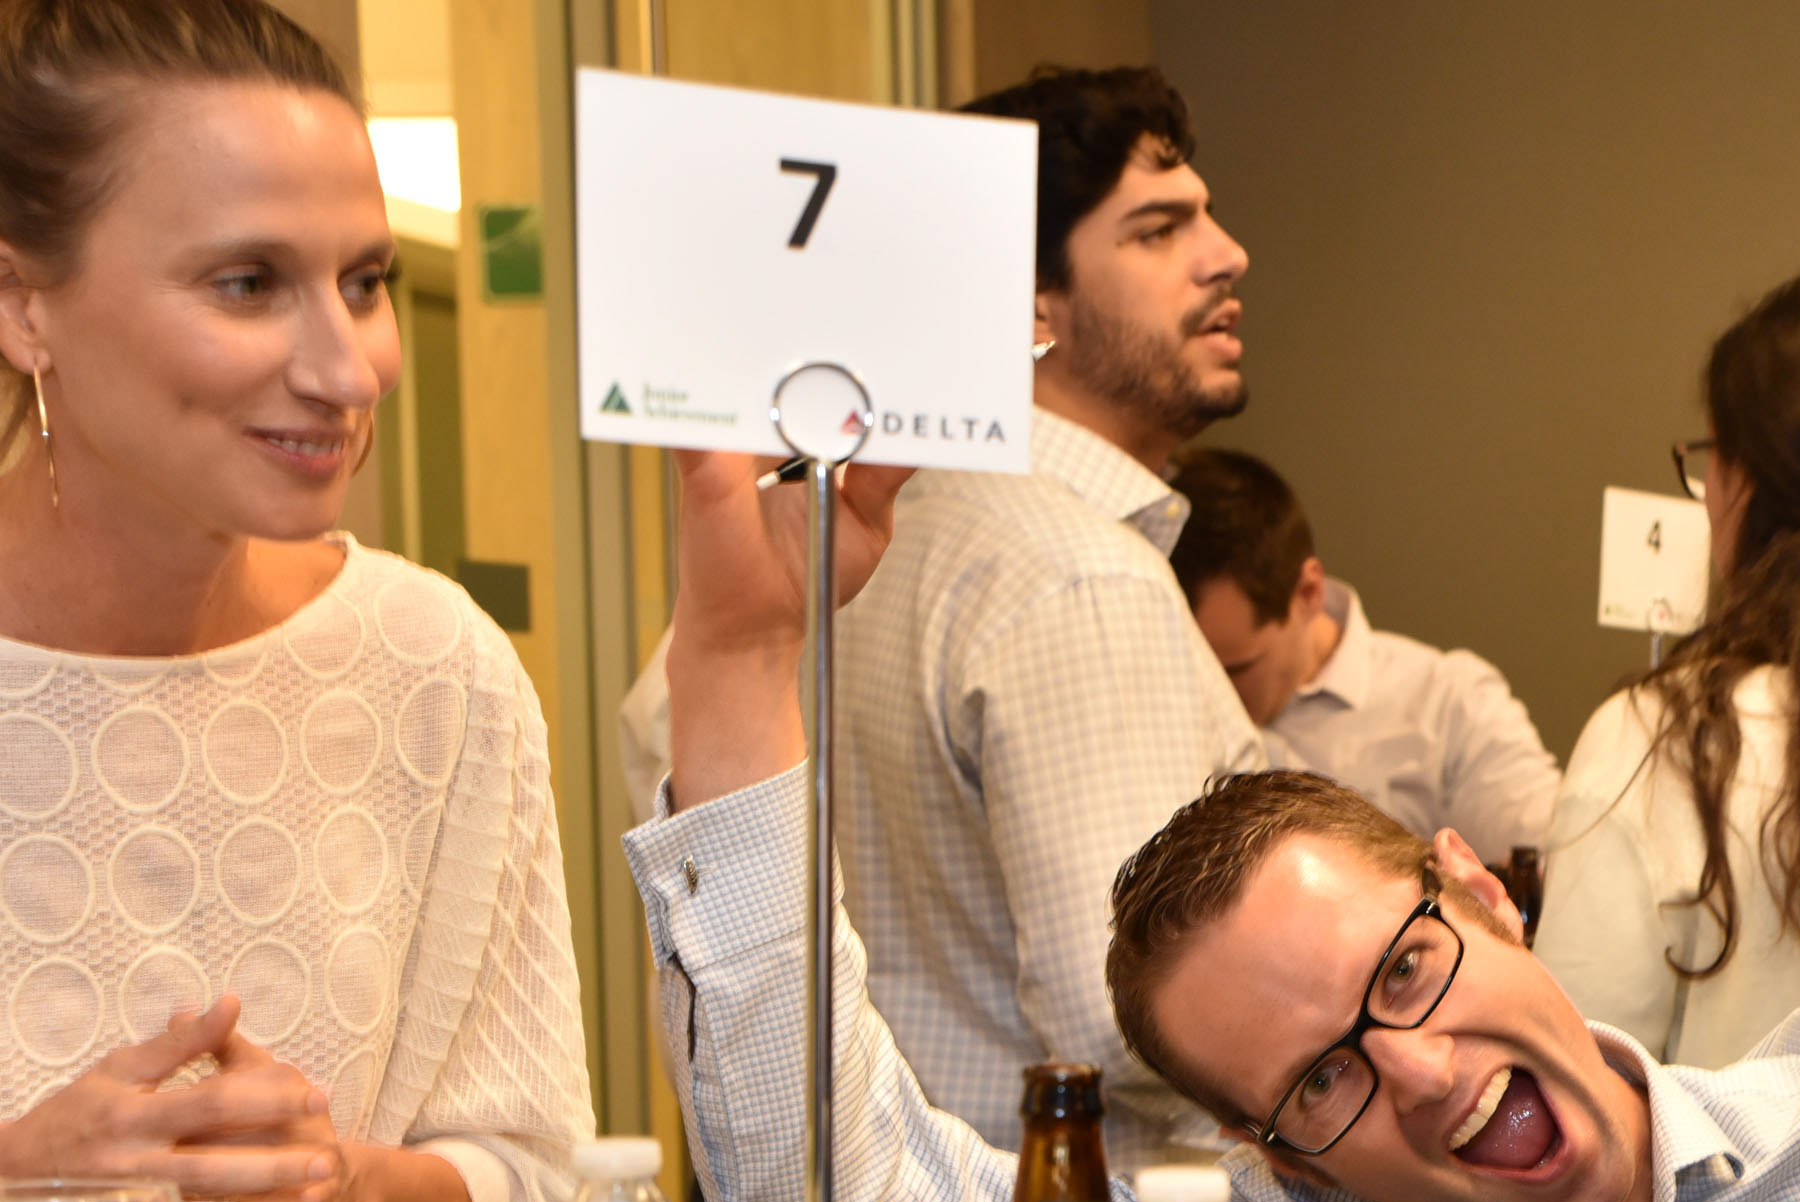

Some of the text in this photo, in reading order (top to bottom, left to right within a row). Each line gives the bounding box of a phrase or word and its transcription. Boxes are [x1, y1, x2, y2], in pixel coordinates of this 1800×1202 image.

[779, 157, 838, 250] 7
[882, 411, 1006, 442] DELTA
[1647, 519, 1662, 553] 4
